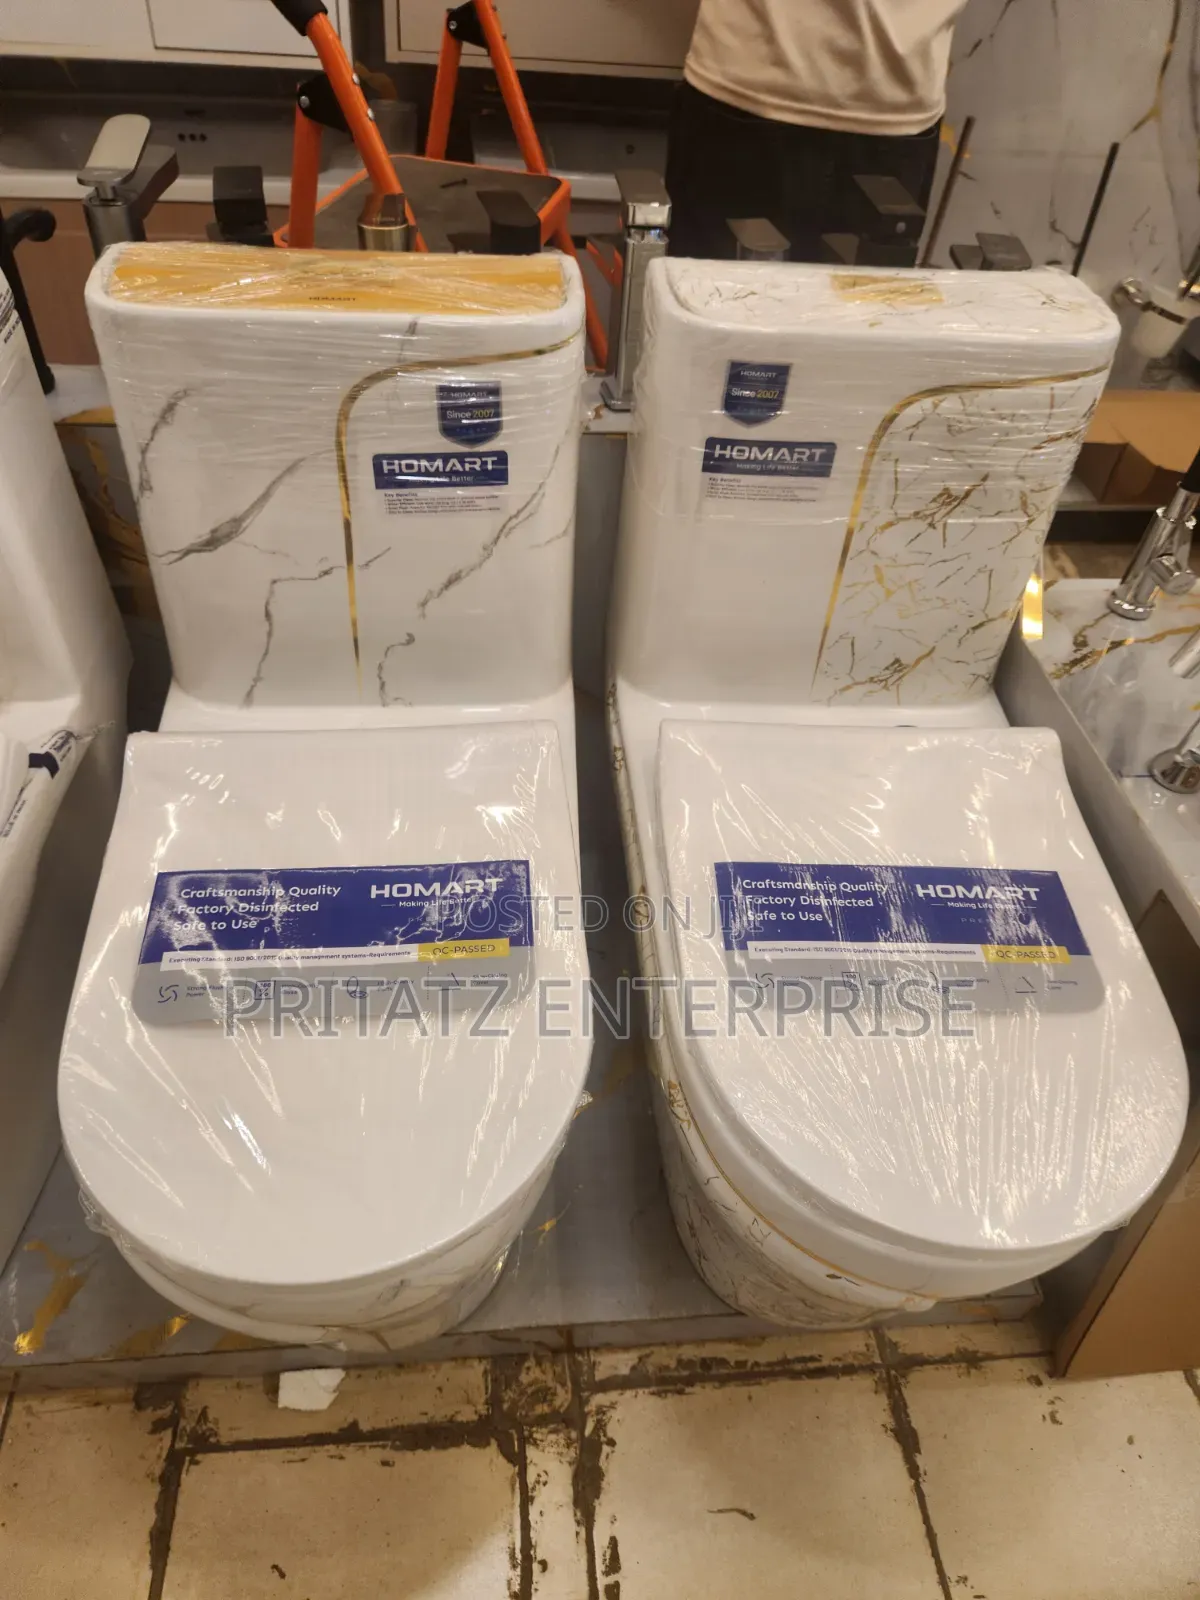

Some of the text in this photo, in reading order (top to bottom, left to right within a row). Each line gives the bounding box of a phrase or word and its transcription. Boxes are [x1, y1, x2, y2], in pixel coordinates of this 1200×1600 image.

[740, 370, 778, 378] HOMART
[731, 387, 780, 399] Since 2007
[446, 409, 495, 419] Since 2007
[713, 444, 828, 462] HOMART
[381, 456, 498, 474] HOMART
[180, 884, 342, 899] Craftsmanship Quality
[370, 878, 504, 899] HOMART
[742, 878, 889, 895] Craftsmanship Quality
[914, 883, 1041, 901] HOMART
[398, 900, 429, 908] Making
[745, 894, 874, 907] Factory Disinfected
[947, 901, 977, 910] Making
[177, 901, 320, 915] Factory Disinfected
[747, 910, 823, 922] Safe to Use
[173, 919, 258, 931] Safe to Use
[432, 943, 496, 956] QC-PASSED
[168, 956, 201, 964] Executing
[300, 953, 340, 961] management
[341, 951, 411, 960] systems-Requirements
